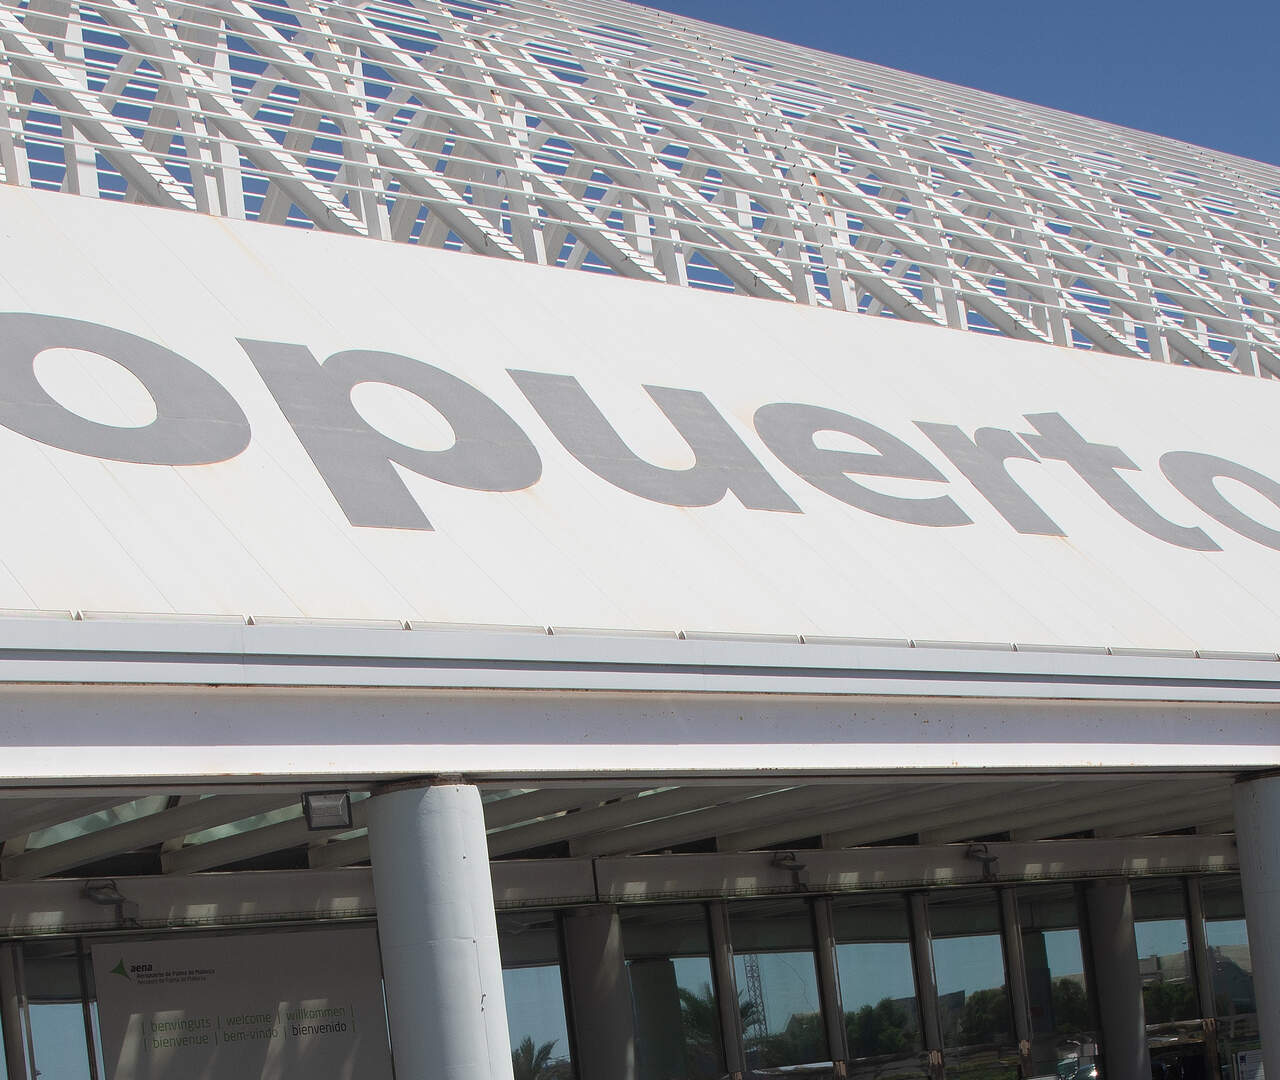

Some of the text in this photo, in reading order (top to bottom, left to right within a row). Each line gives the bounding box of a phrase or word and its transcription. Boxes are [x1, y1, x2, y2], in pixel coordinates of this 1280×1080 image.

[130, 964, 153, 973] aena
[152, 1006, 345, 1033] benvinguts welcome willkommen
[152, 1021, 347, 1049] bienvenue bem-vindo bienvenido
